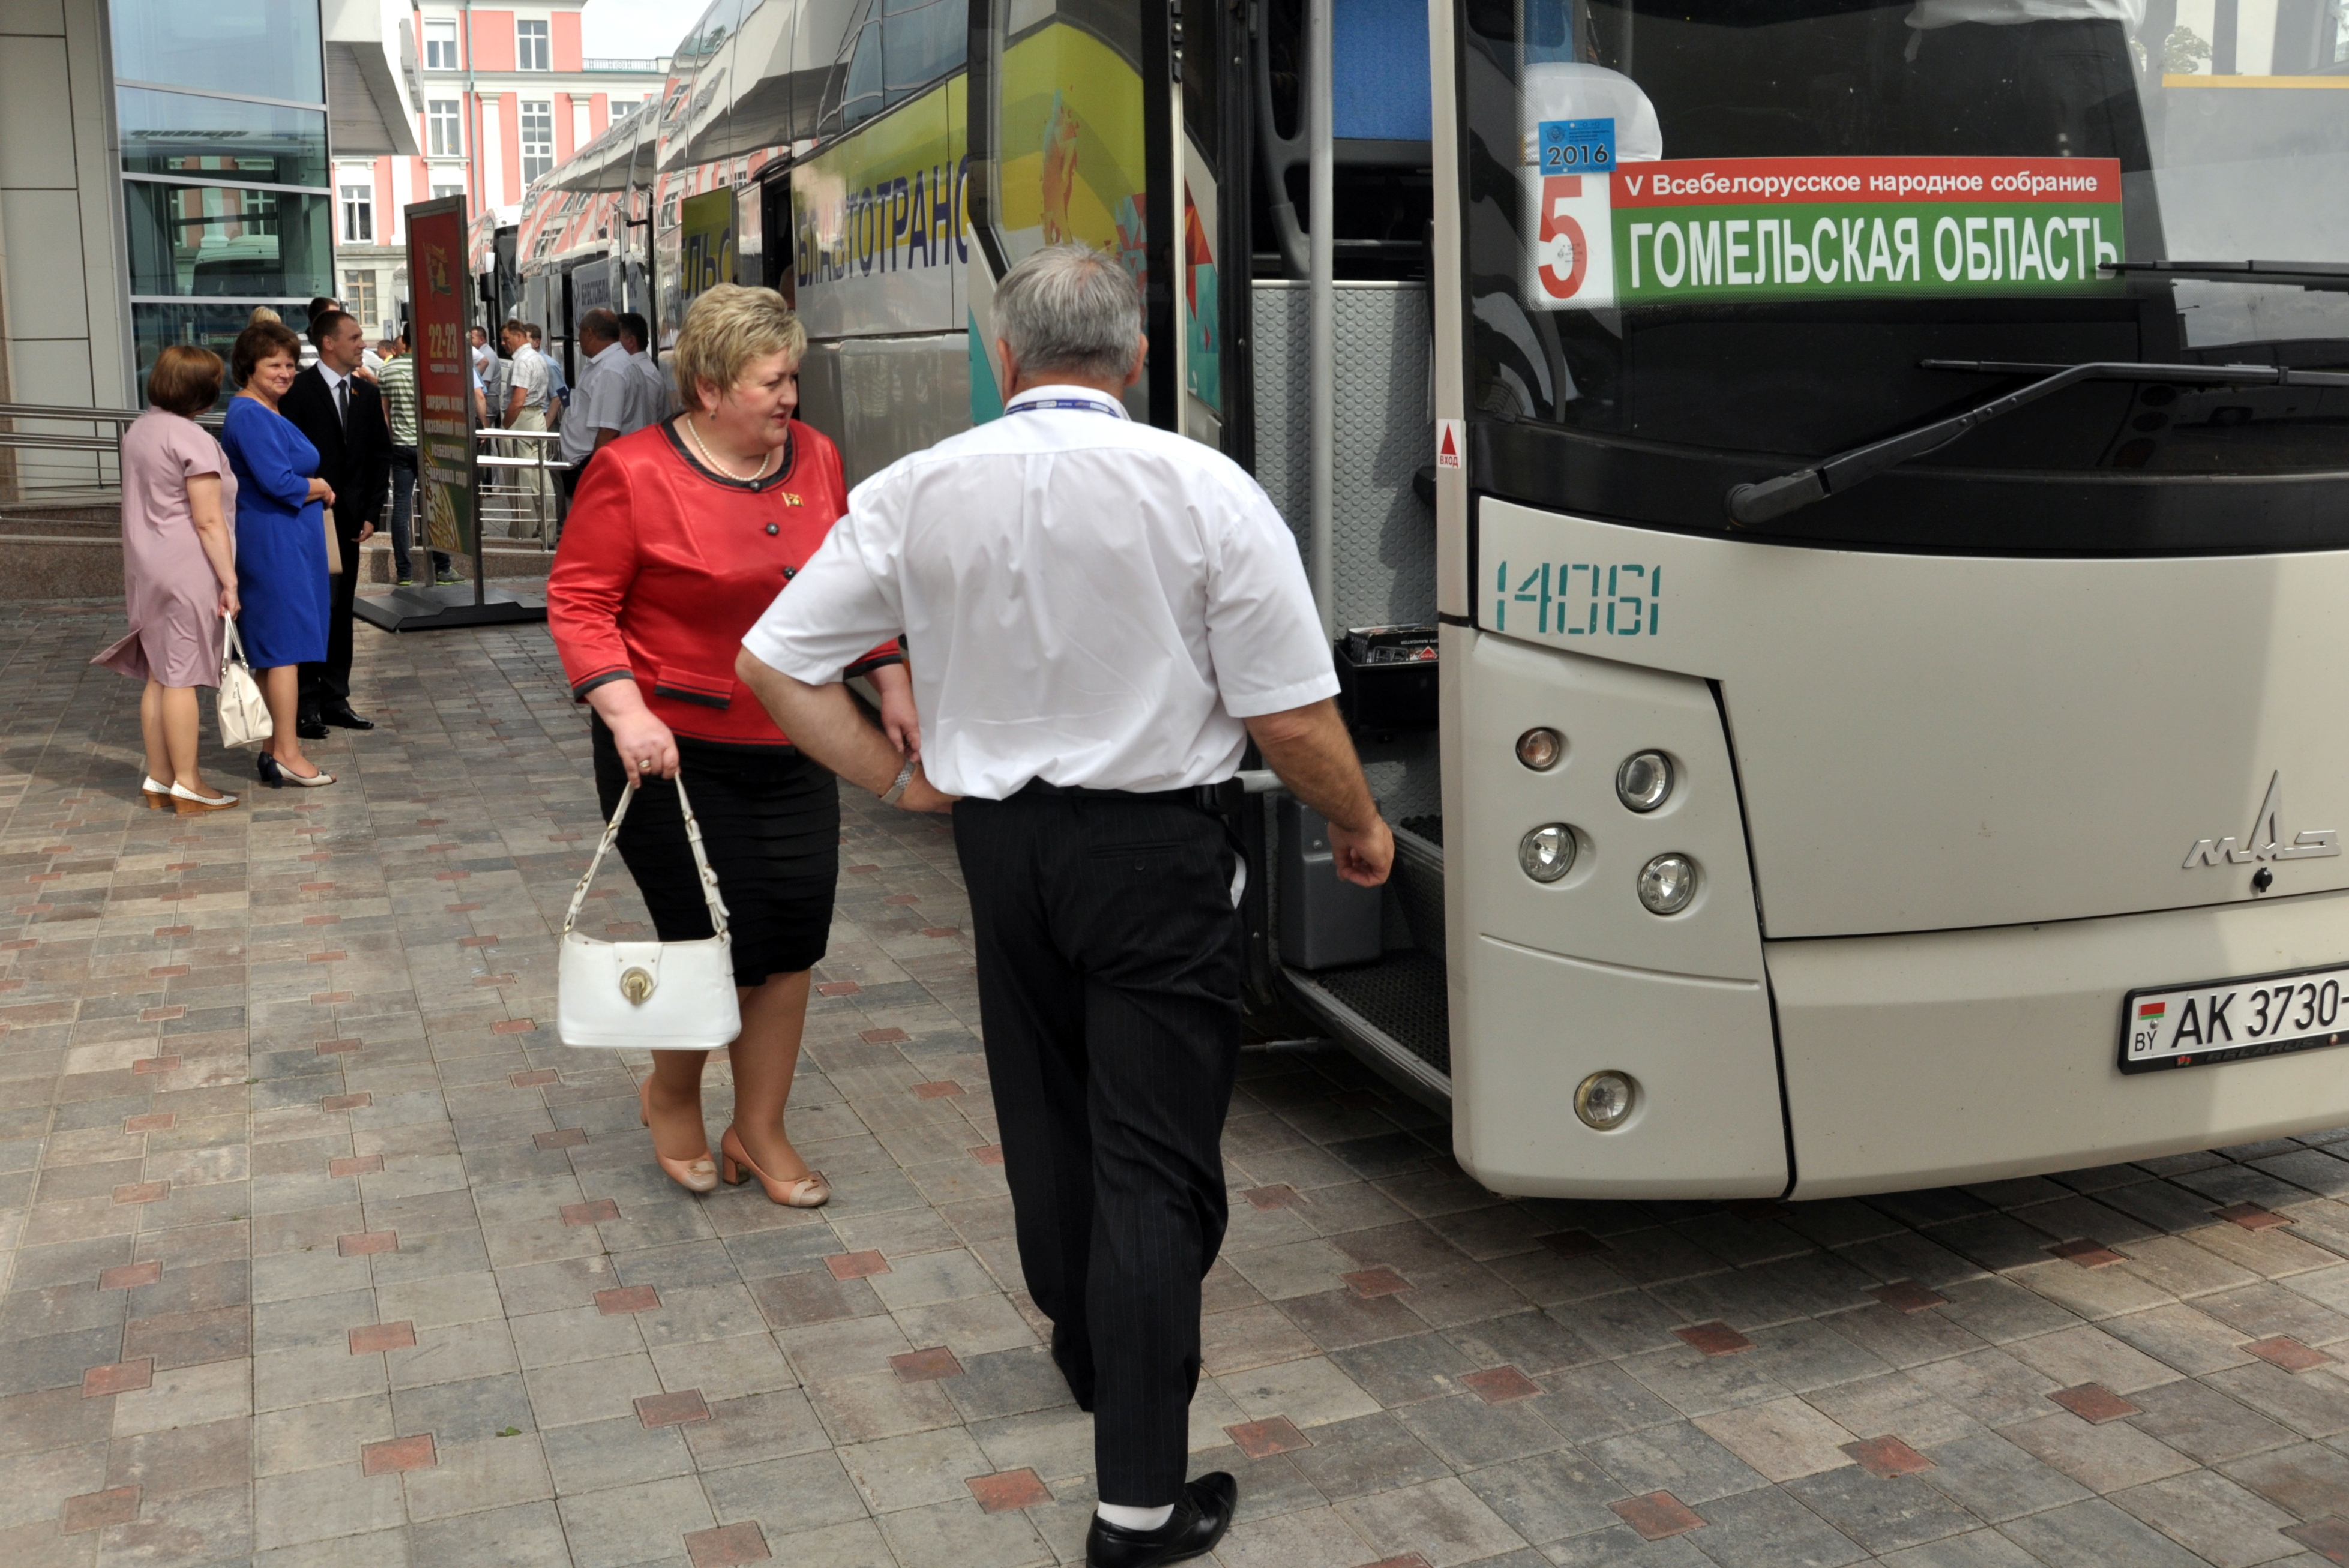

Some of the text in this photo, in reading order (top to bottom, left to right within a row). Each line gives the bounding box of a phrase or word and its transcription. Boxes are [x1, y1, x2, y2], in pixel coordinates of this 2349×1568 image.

[1547, 143, 1610, 166] 2016
[1625, 171, 2098, 197] V Всебелорусское народное собрание
[1538, 175, 1588, 299] 5
[1629, 215, 2119, 289] ГОМЕЛЬСКАЯ ОБЛАСТЬ
[428, 322, 458, 359] 22-23
[1439, 455, 1459, 469] ВХОД
[2134, 1030, 2158, 1052] BY
[2170, 991, 2237, 1048] AK
[2206, 1039, 2317, 1062] BELARUS
